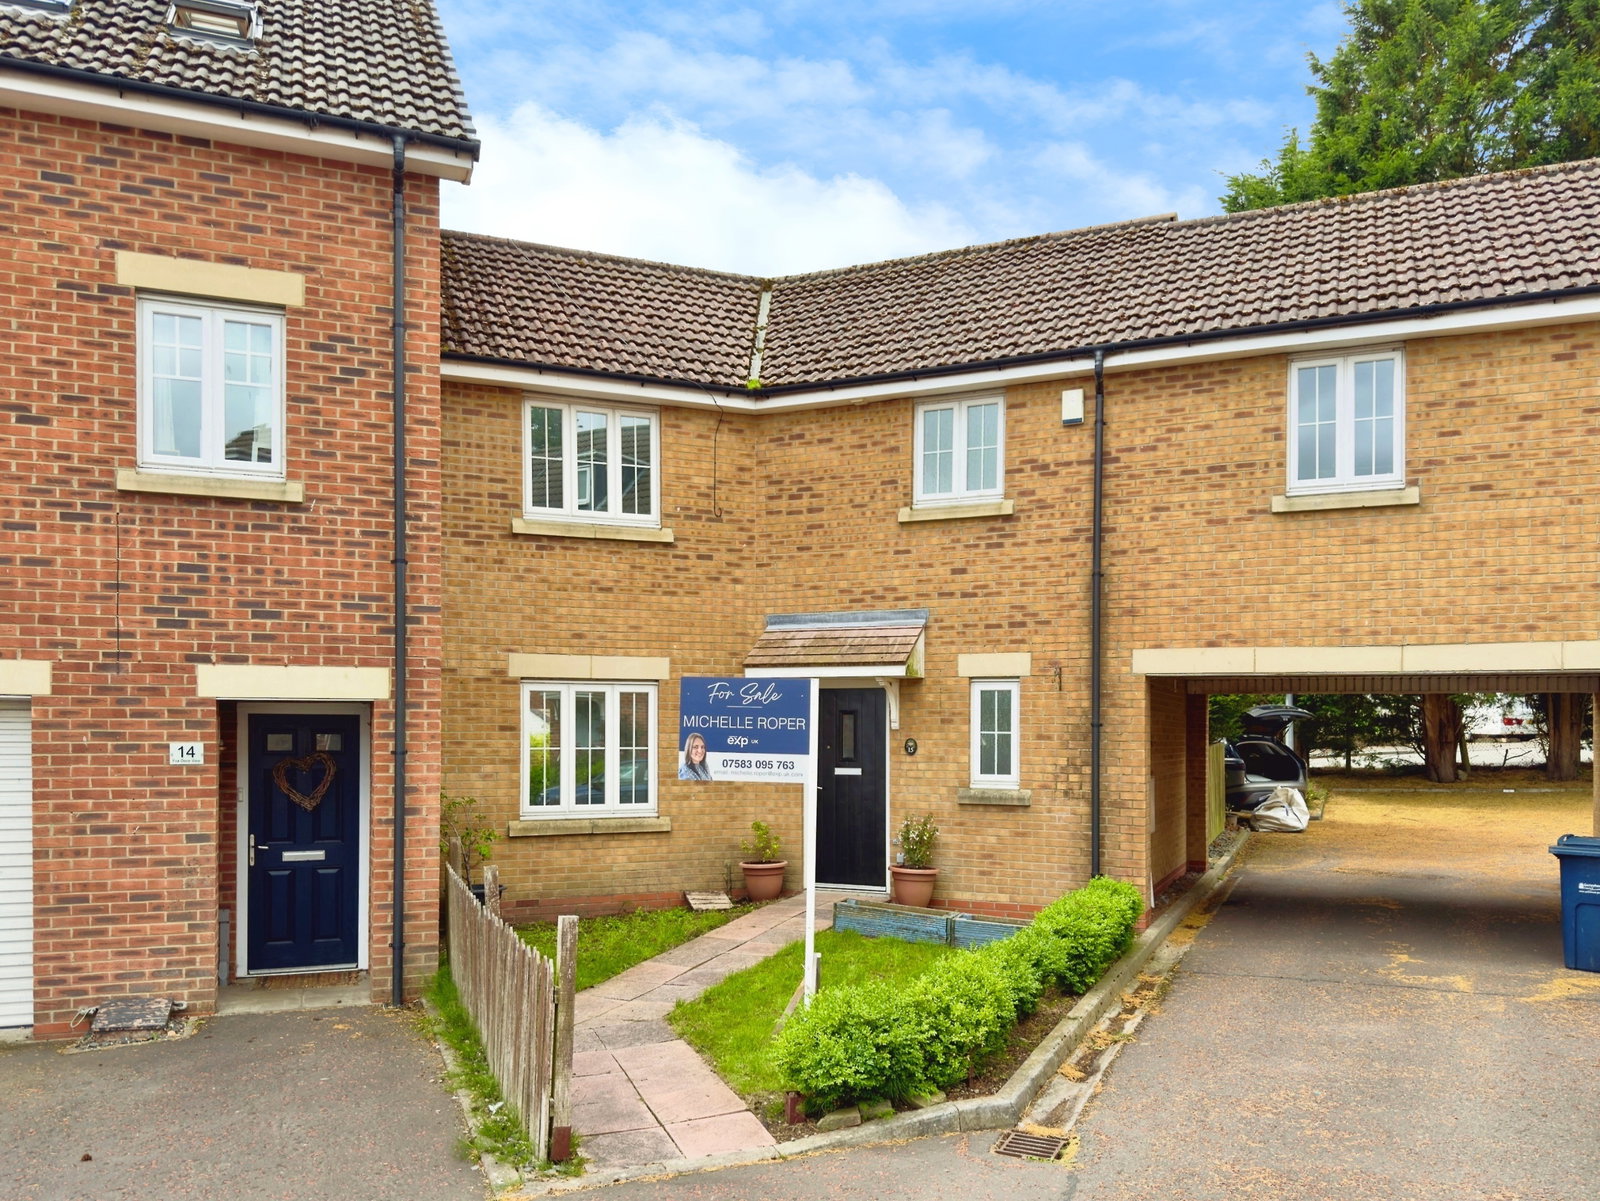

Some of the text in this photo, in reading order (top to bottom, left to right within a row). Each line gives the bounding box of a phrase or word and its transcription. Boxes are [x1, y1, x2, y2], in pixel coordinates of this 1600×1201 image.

[707, 682, 782, 705] For Sale
[683, 715, 806, 730] MICHELLE ROPER
[177, 745, 196, 758] 14
[722, 759, 795, 770] 07583 095 763
